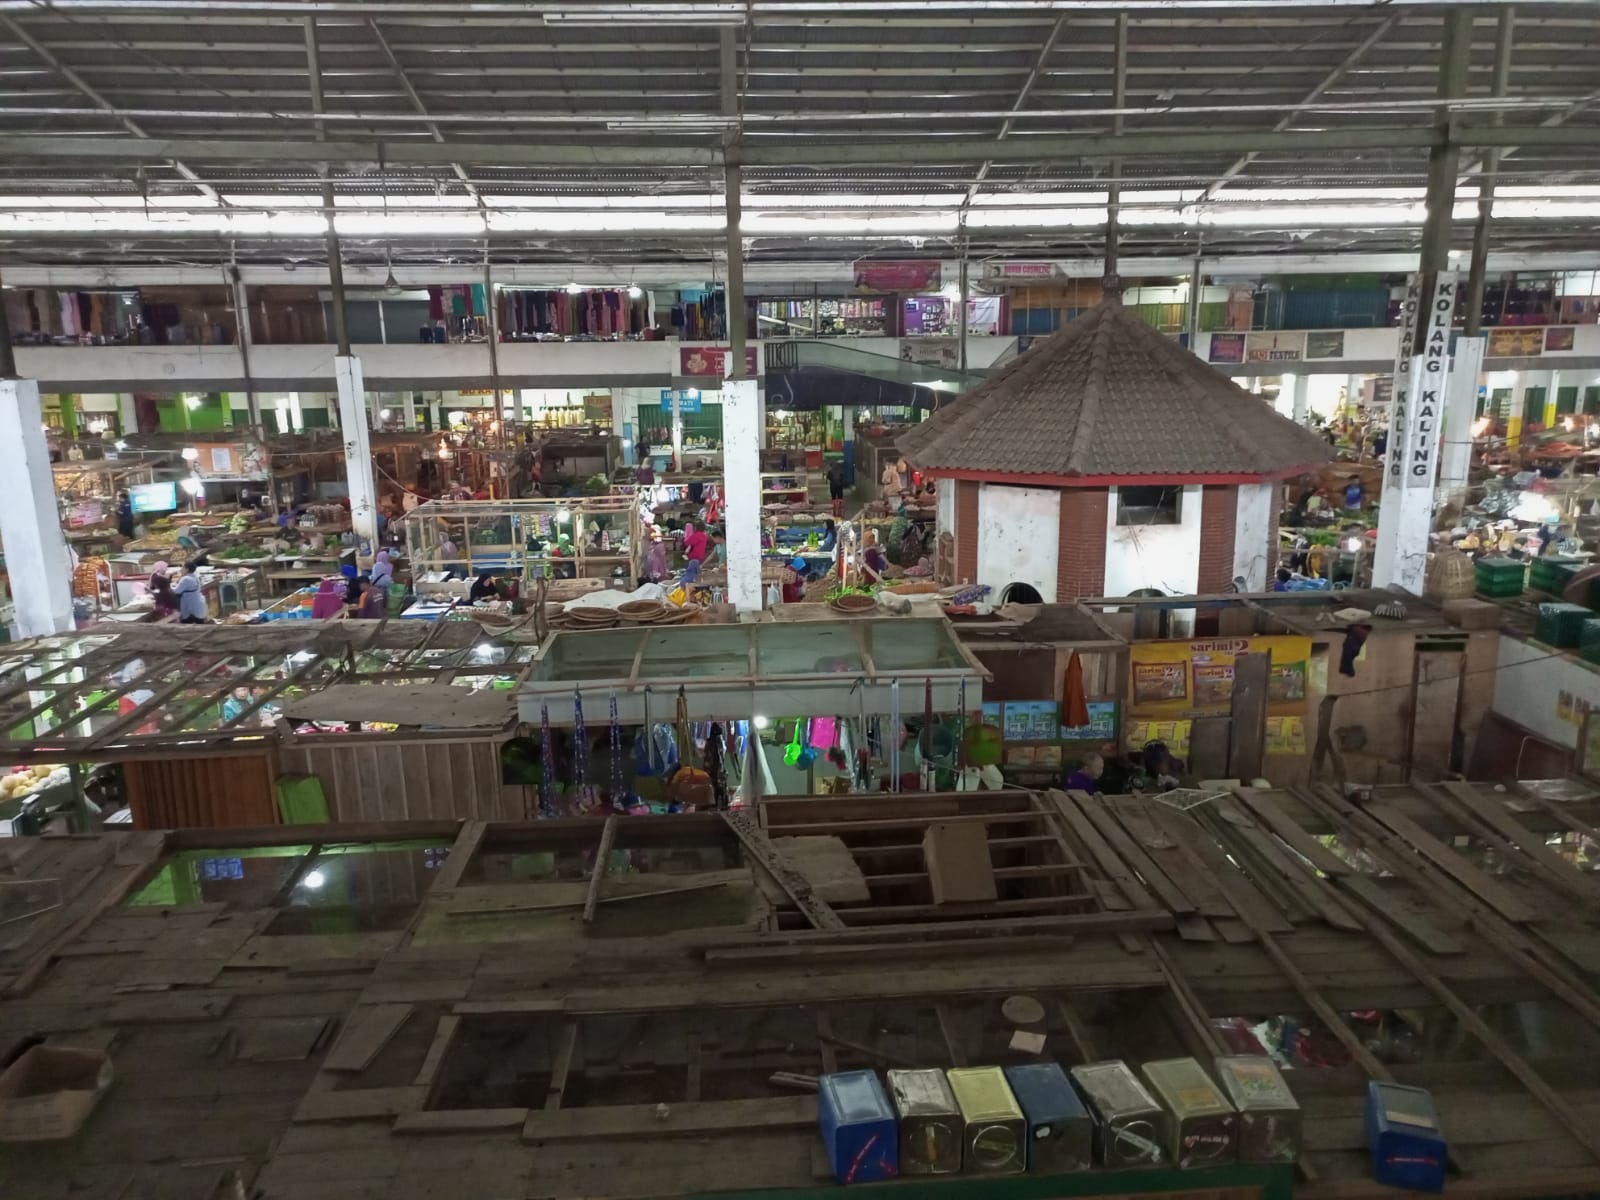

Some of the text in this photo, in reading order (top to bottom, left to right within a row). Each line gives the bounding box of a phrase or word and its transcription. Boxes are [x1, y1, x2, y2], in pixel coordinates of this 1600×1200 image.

[1391, 286, 1418, 476] KOLANG KALING
[1413, 283, 1452, 476] KOLANG KALING
[1191, 640, 1233, 651] sarimi
